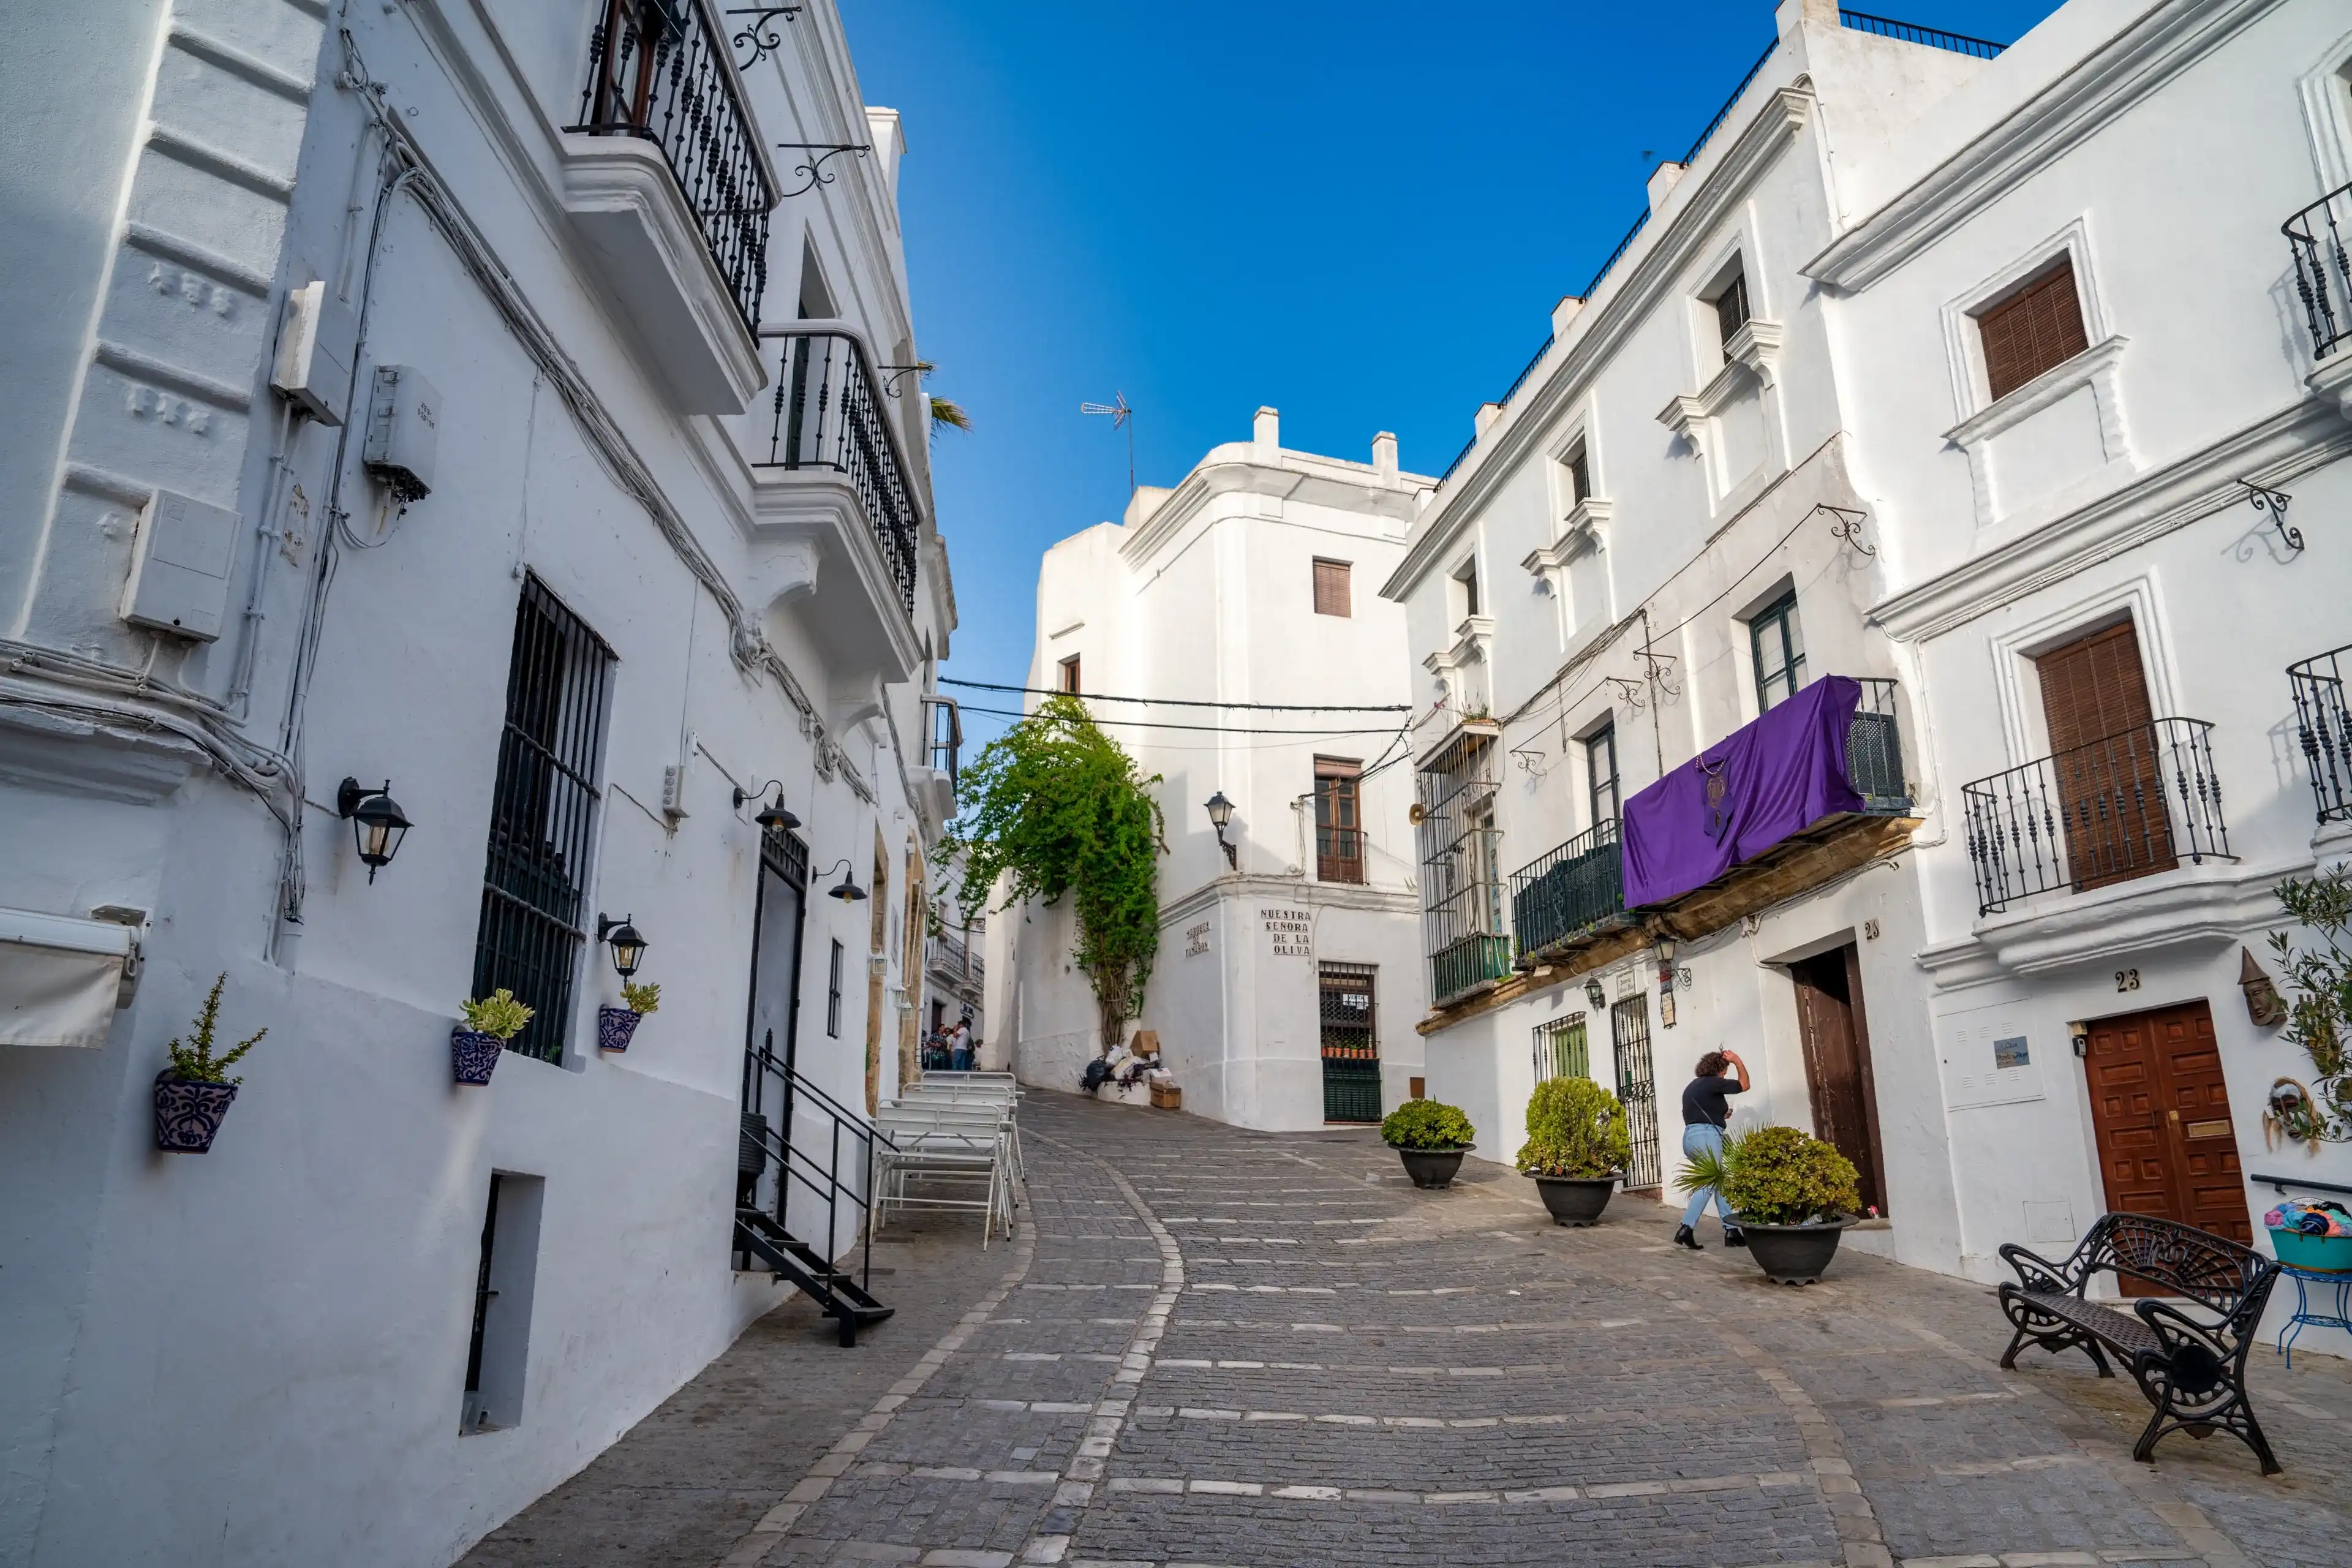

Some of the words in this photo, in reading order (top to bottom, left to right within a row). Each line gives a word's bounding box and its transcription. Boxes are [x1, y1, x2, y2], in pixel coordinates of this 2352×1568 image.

[1261, 910, 1310, 919] NUESTRA
[1266, 922, 1308, 931] SEÑORA
[1295, 935, 1308, 943] LA
[1275, 945, 1309, 954] OLIVA
[2115, 968, 2139, 992] 23
